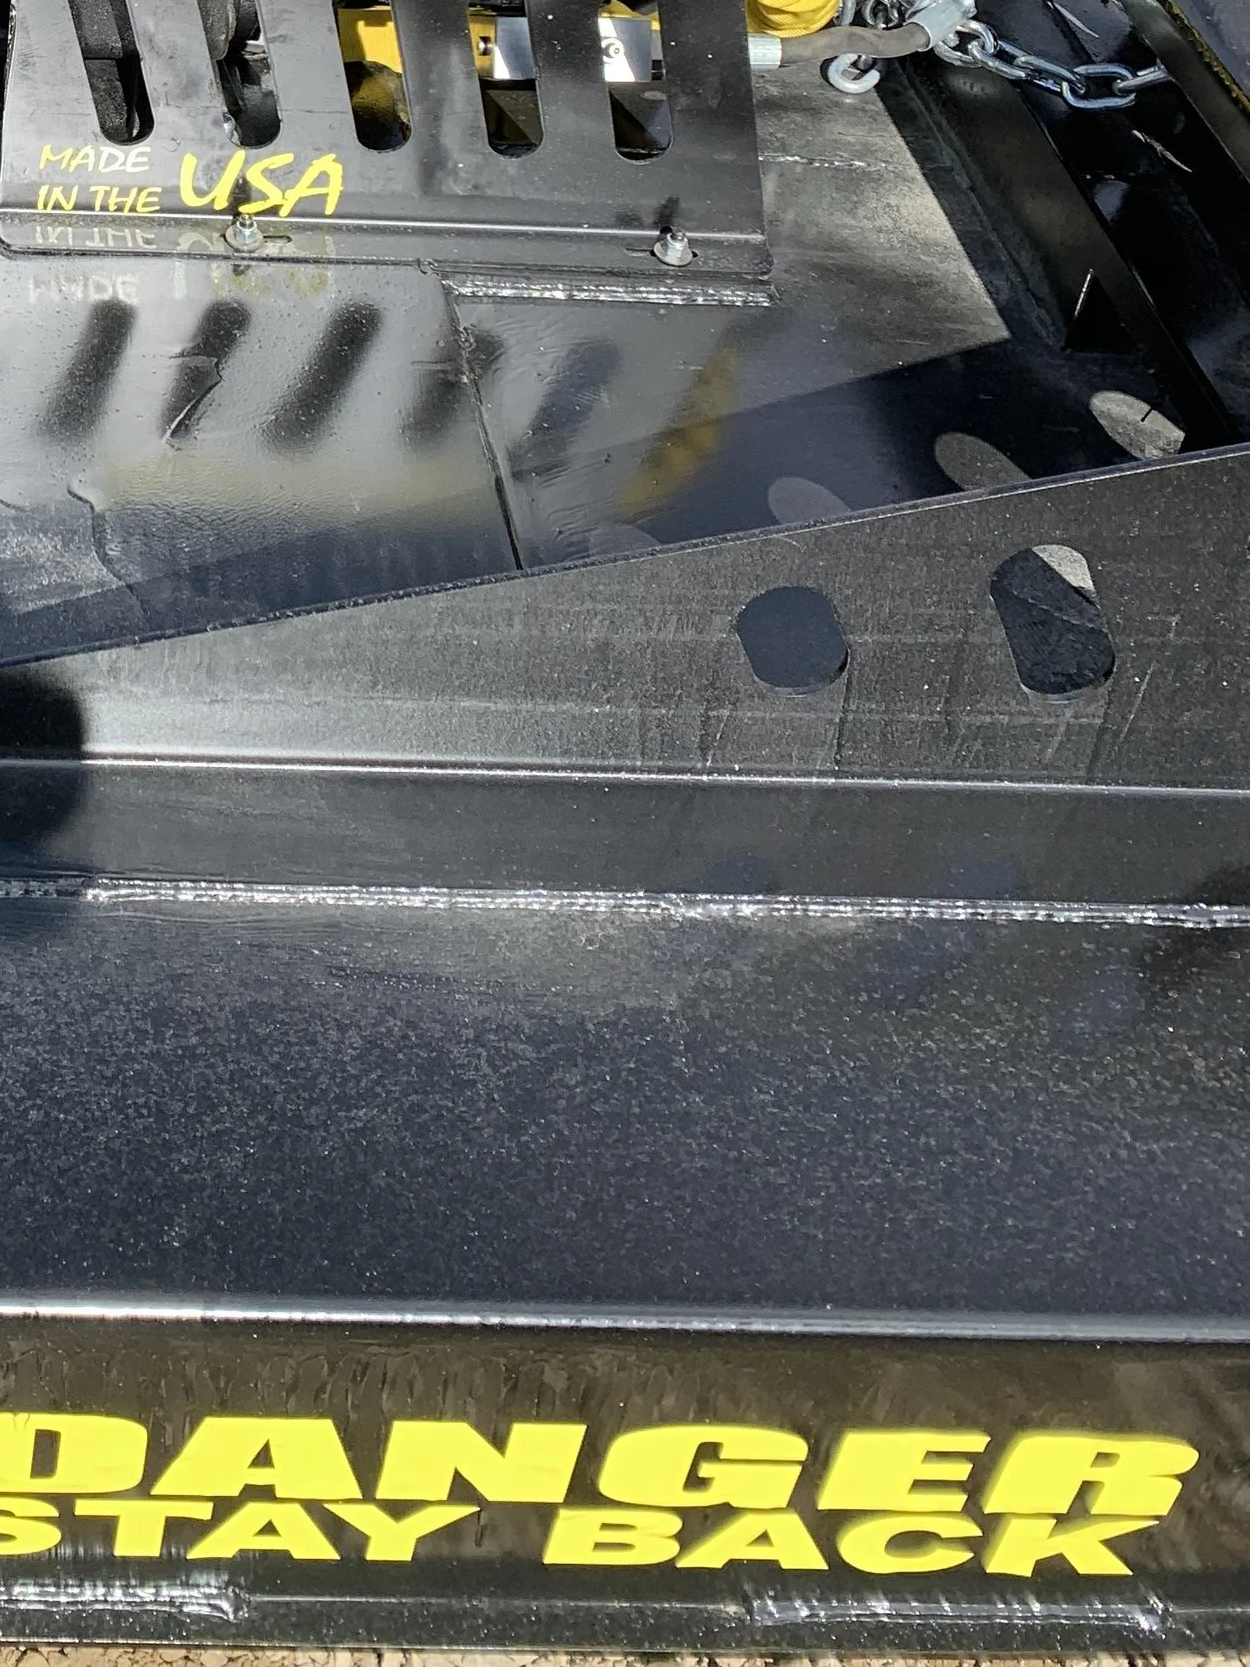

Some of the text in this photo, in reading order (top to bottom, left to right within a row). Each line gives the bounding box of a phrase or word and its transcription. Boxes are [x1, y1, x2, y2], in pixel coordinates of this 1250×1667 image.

[38, 144, 151, 173] MADE
[36, 185, 162, 215] IN THE
[179, 150, 344, 218] USA
[542, 1506, 1160, 1578] BACK
